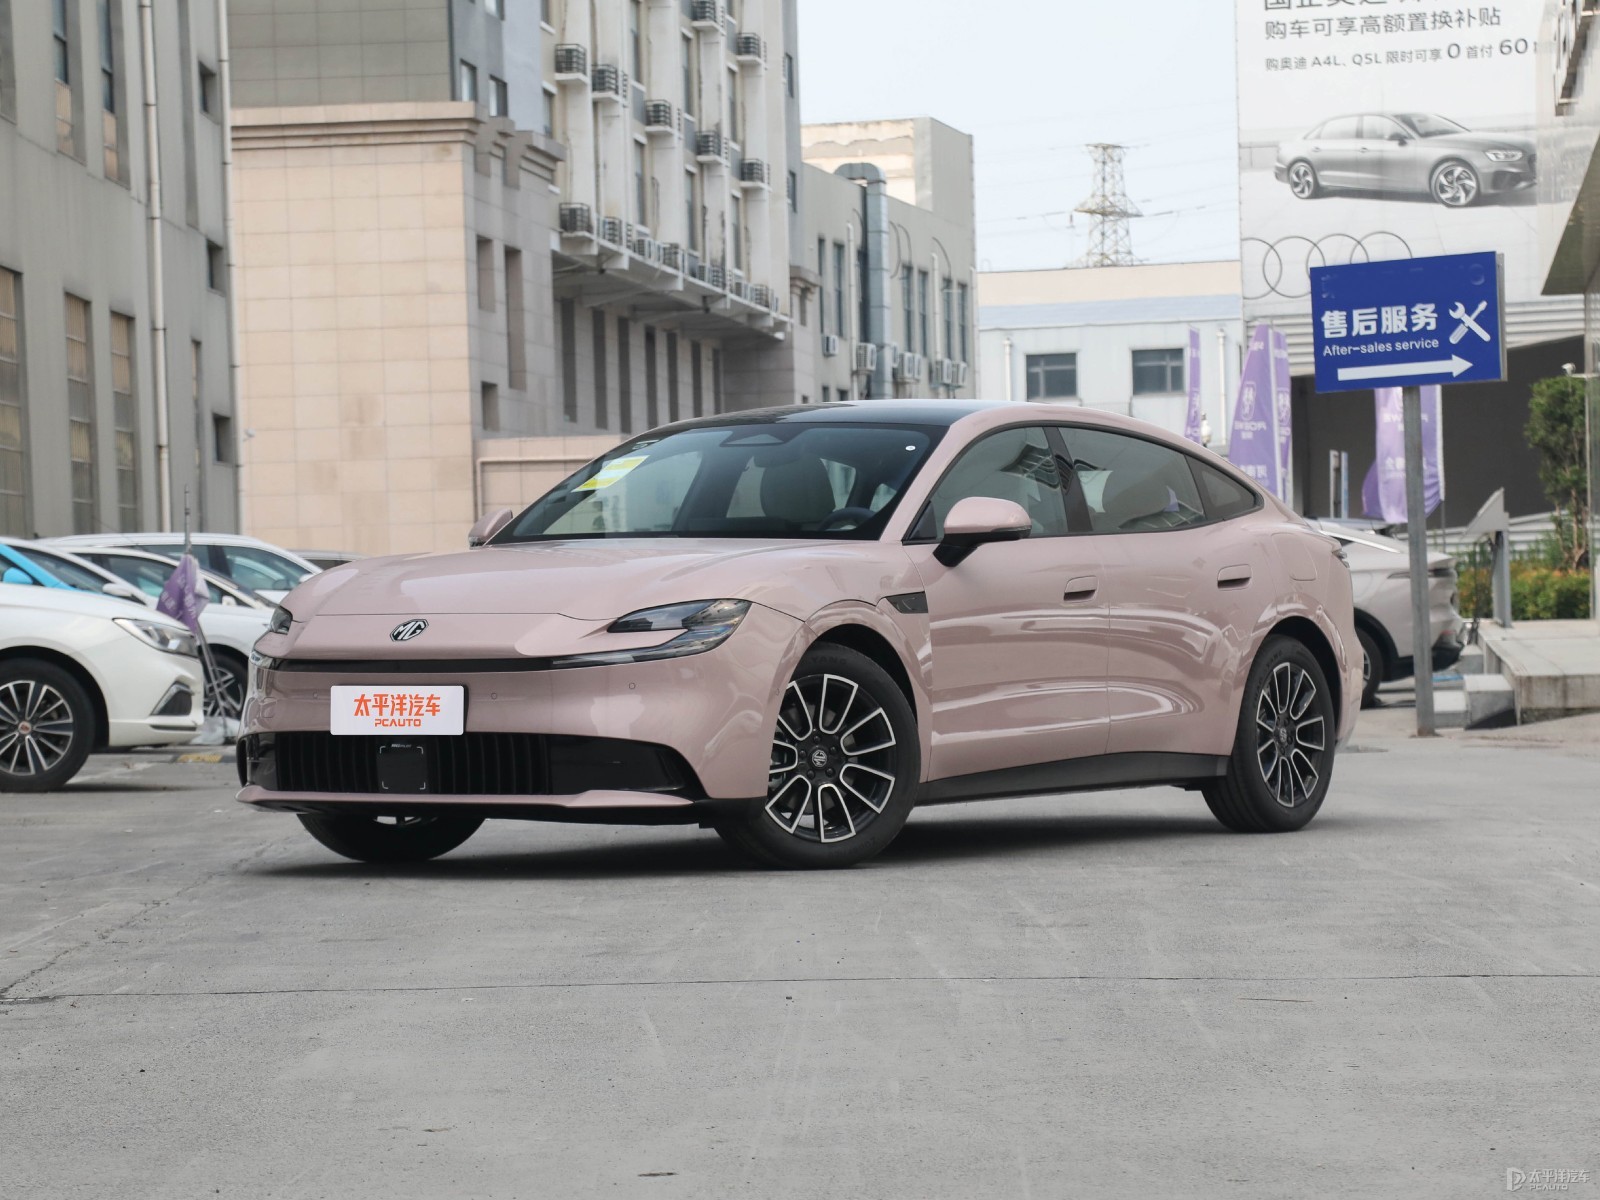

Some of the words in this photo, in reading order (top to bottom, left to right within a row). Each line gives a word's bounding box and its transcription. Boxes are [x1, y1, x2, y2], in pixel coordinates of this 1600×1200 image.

[1264, 7, 1501, 40] 购车可享高额置换补贴
[1265, 56, 1307, 71] 购奥迪
[1386, 48, 1443, 64] 限时可享
[1466, 44, 1493, 60] 首付
[1499, 38, 1528, 55] 60
[1321, 302, 1438, 339] 售后服务
[1323, 341, 1393, 357] After-sales
[1395, 338, 1440, 351] service
[391, 619, 428, 641] MG
[353, 693, 441, 717] 太平洋汽车
[374, 718, 422, 727] PCAUTO
